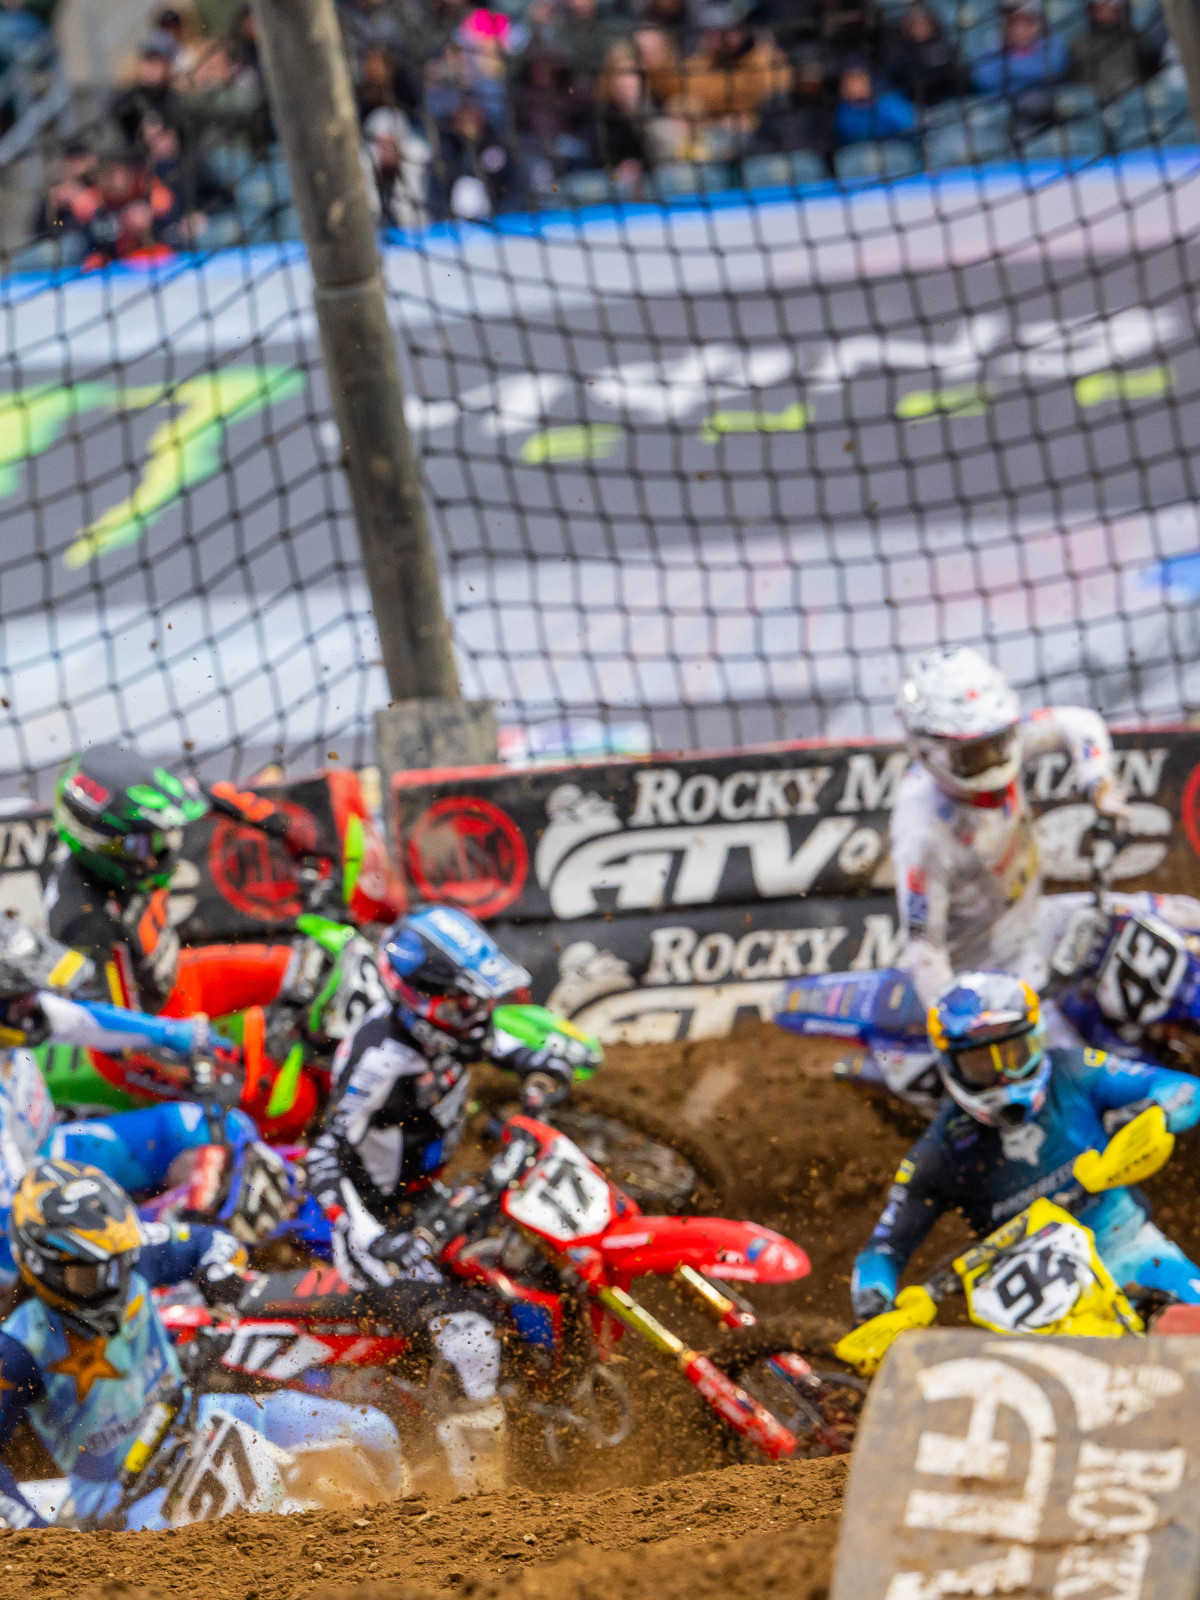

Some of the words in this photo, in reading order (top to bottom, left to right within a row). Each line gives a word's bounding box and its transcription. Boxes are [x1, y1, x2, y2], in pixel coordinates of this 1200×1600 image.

[628, 765, 834, 829] ROCKY
[550, 816, 856, 920] ATV
[642, 926, 848, 987] ROCKY
[538, 1156, 592, 1232] 17
[997, 1246, 1078, 1329] 94
